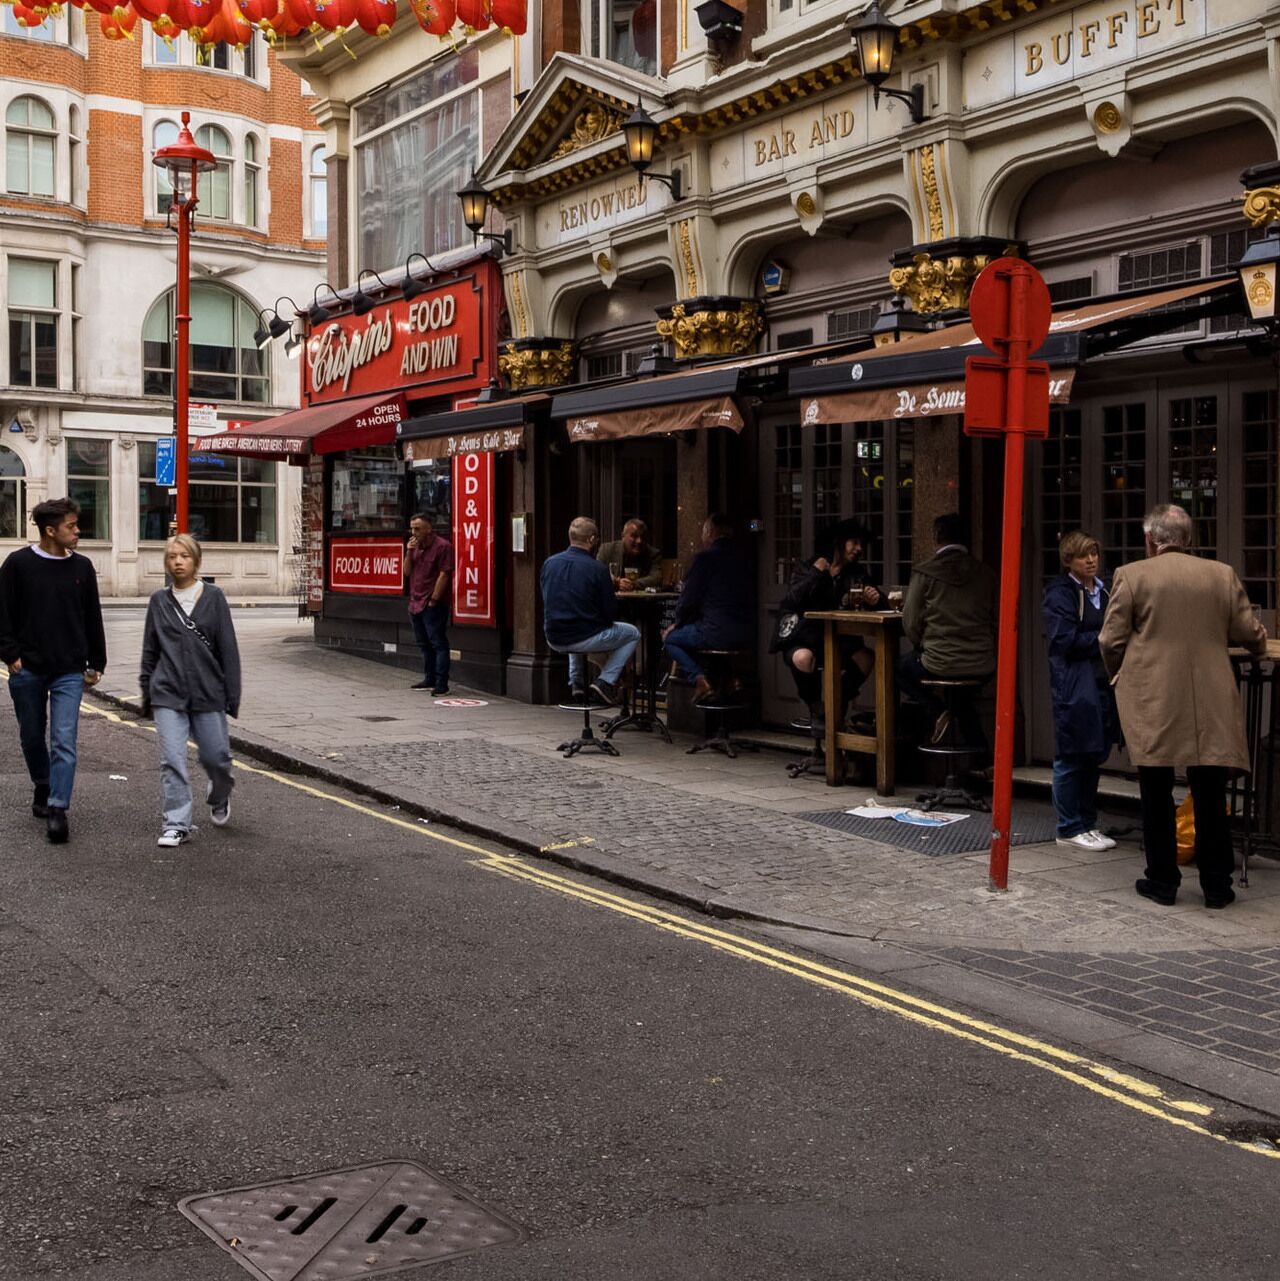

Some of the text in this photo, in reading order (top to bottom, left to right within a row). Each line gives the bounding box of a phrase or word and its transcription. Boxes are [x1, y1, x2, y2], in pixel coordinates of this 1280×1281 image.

[754, 109, 856, 167] BAR AND
[559, 181, 648, 233] RENOWNED
[307, 294, 455, 392] Crispins FOOD
[400, 333, 458, 376] AND WIN
[356, 413, 401, 428] 24 HOURS
[373, 404, 400, 416] OPEN
[894, 390, 917, 417] De
[199, 437, 211, 450] FOOD
[283, 439, 303, 452] LOTTERY
[503, 429, 520, 449] Bar
[464, 453, 480, 495] OD
[335, 557, 399, 575] FOOD & WINE
[463, 522, 481, 608] WINE
